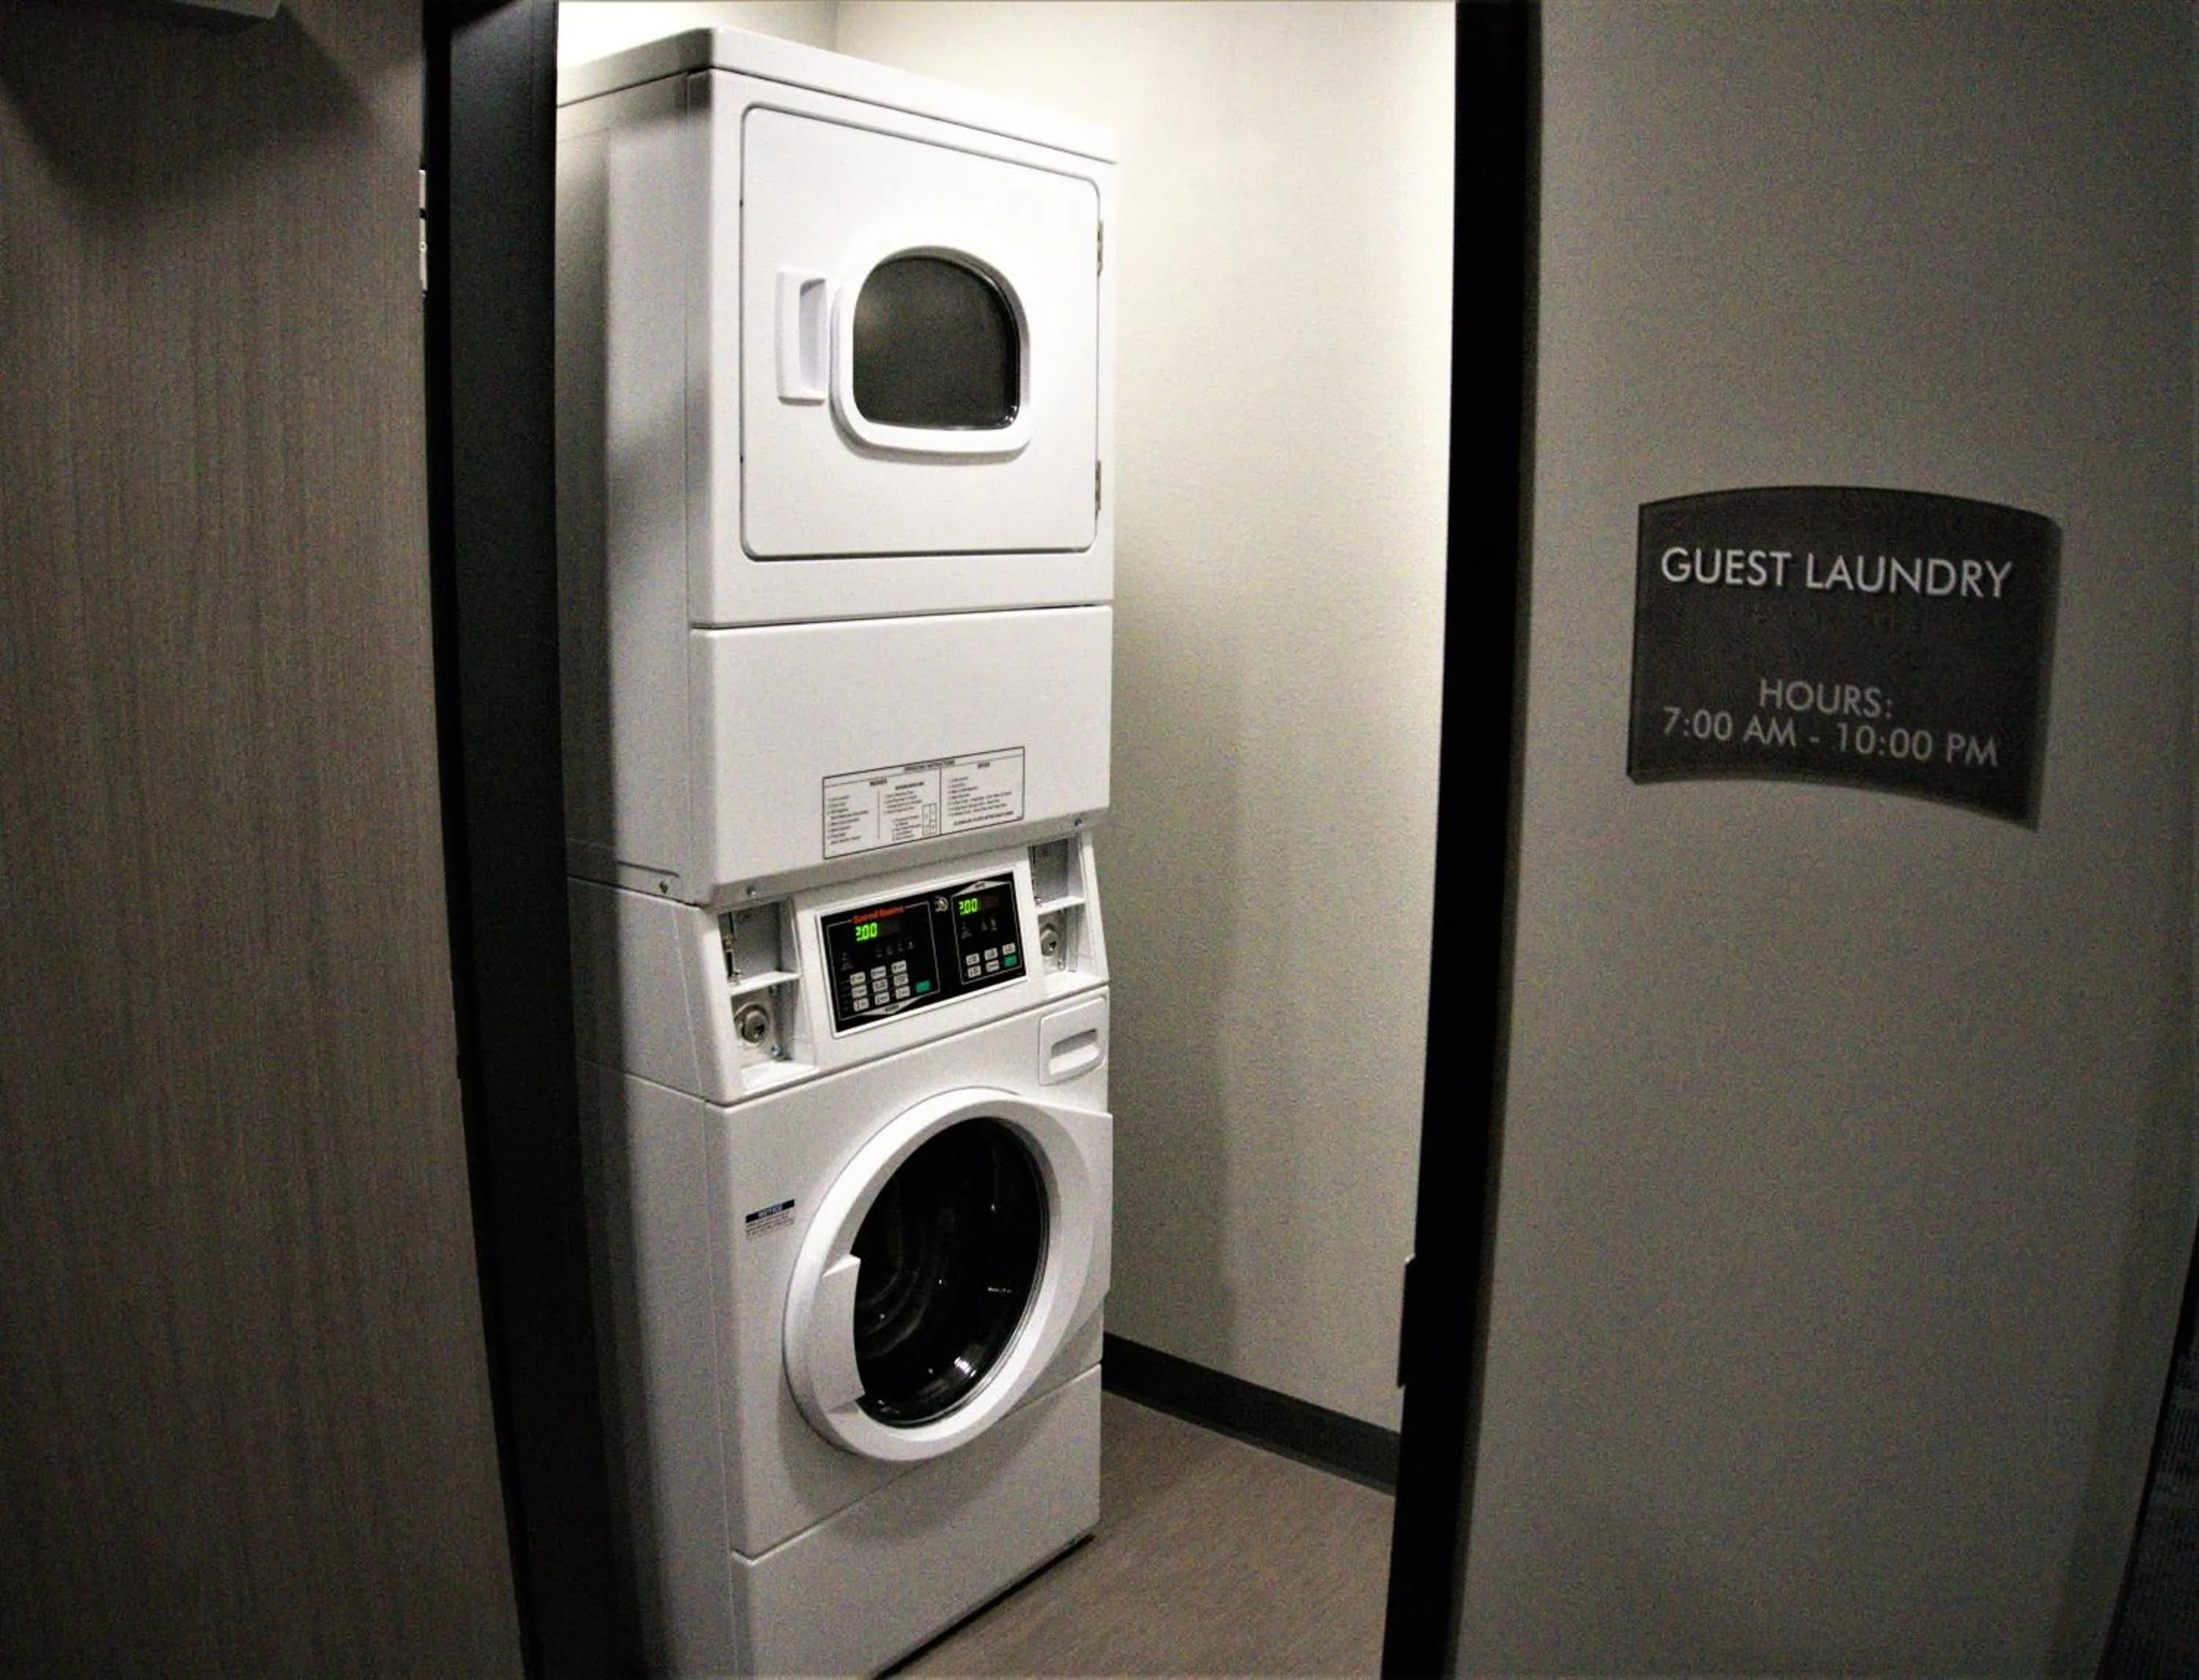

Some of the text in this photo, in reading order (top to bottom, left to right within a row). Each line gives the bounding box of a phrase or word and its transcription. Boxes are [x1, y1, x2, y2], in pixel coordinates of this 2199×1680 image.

[1661, 546, 2012, 598] GUEST LAUNDRY
[1759, 677, 1893, 719] HOURS:
[1662, 704, 1733, 740] 7:00
[1742, 715, 1796, 749] AM
[1838, 723, 1933, 760] 10:00
[1946, 733, 1997, 767] PM
